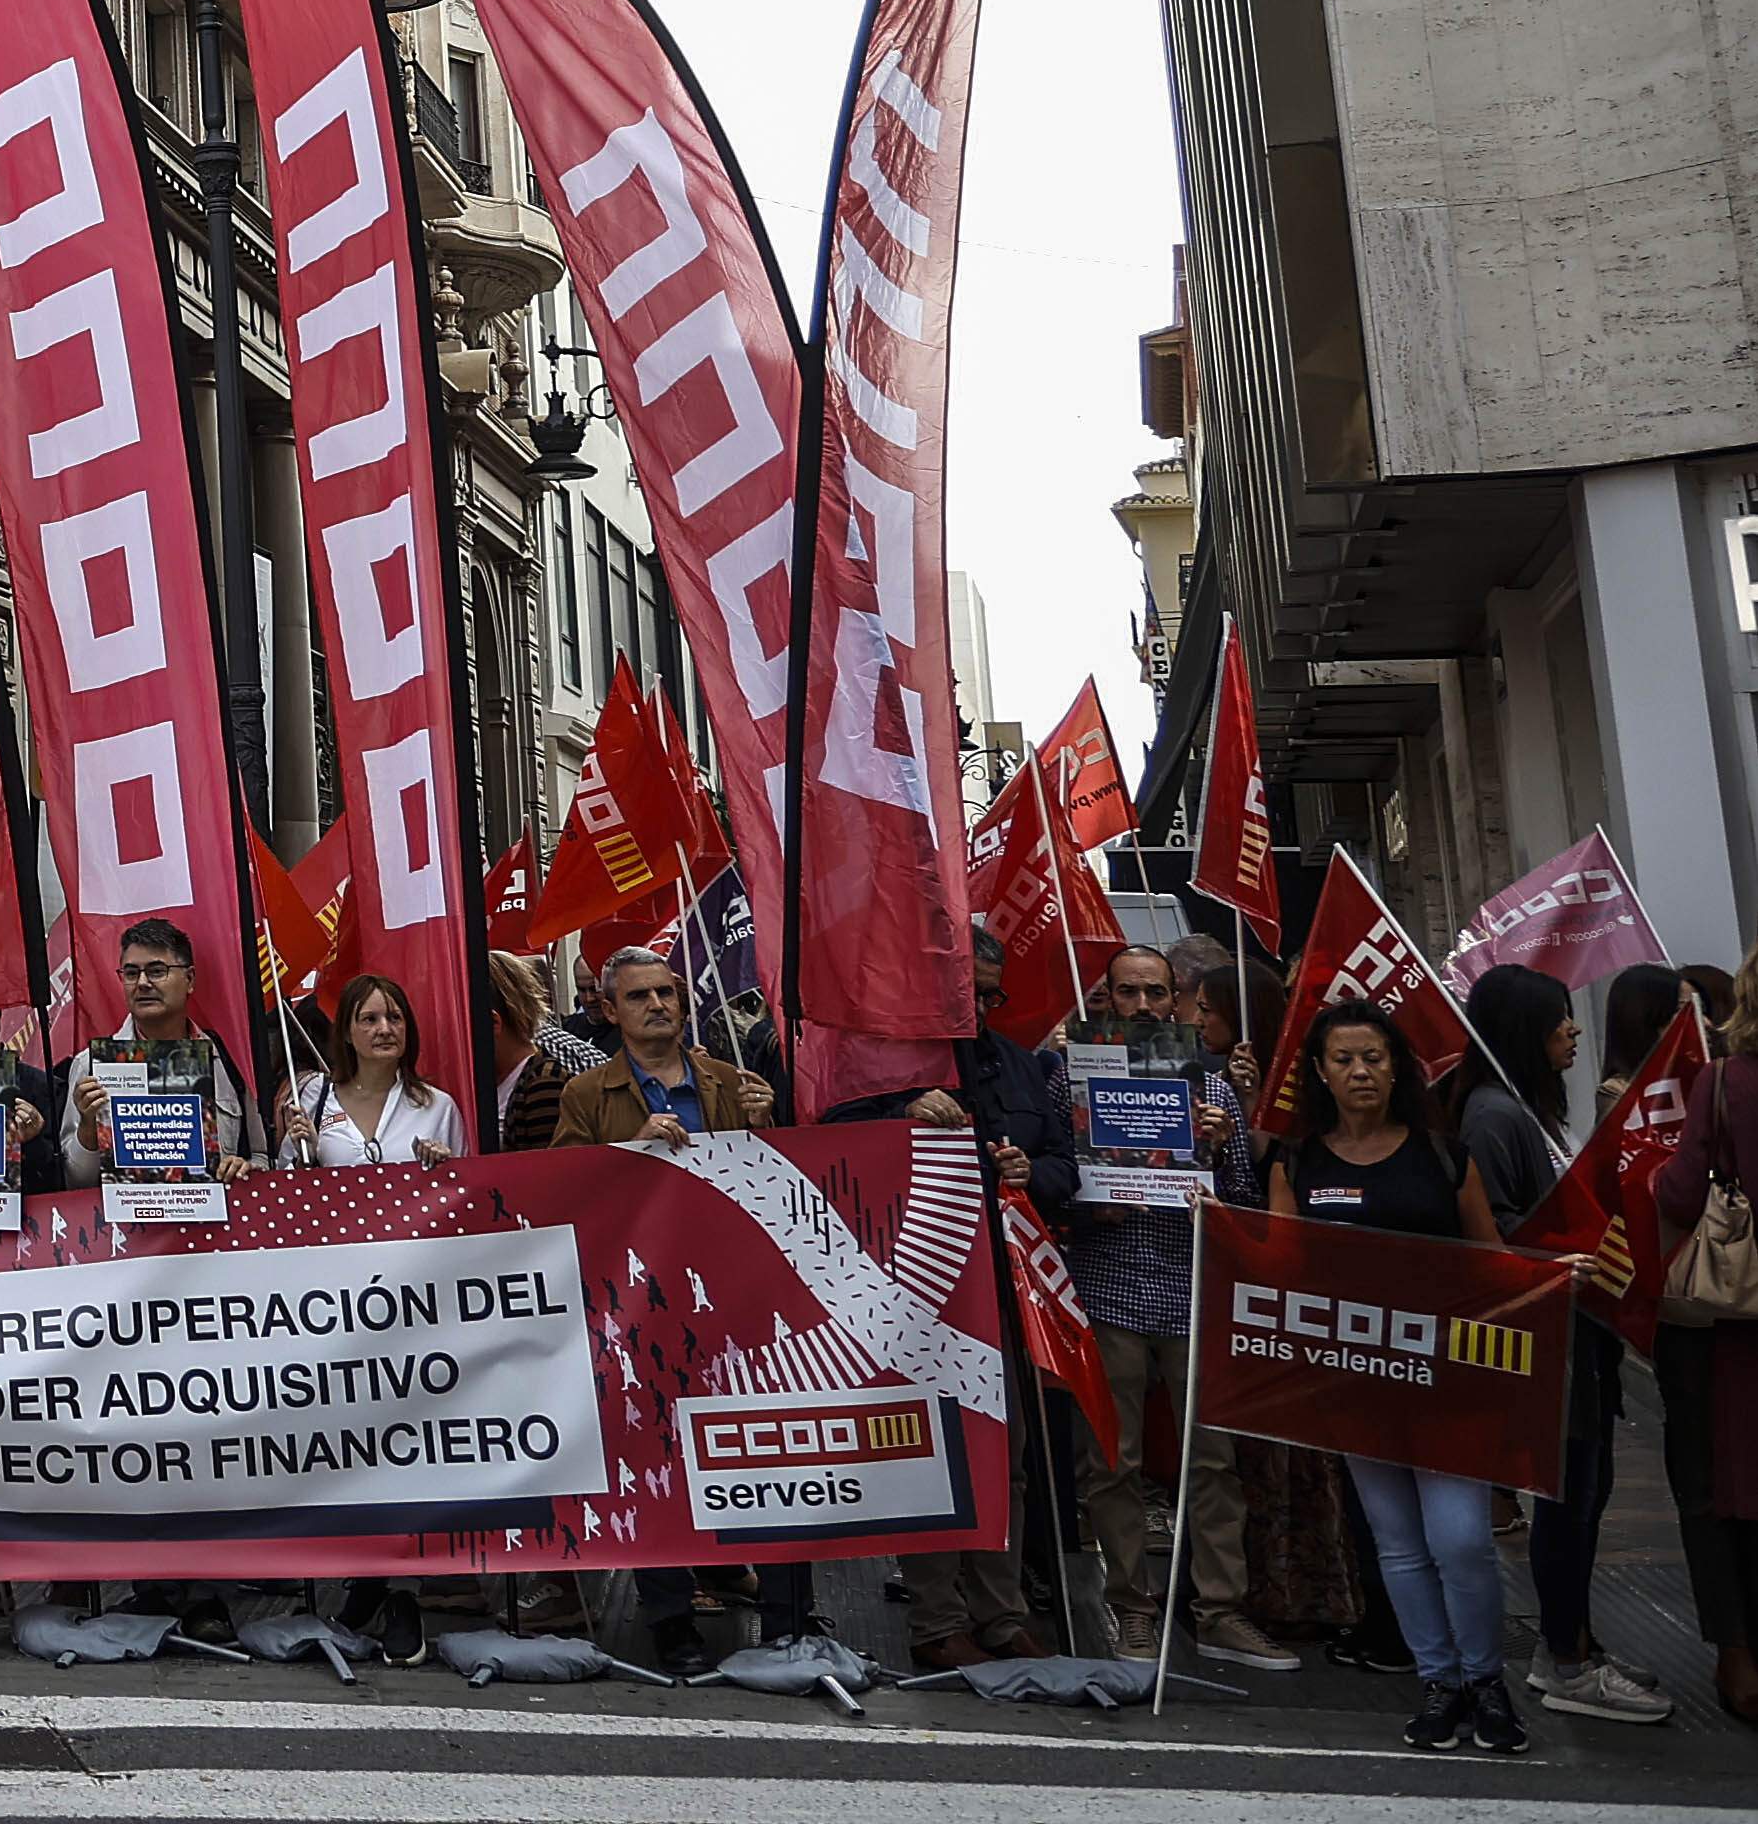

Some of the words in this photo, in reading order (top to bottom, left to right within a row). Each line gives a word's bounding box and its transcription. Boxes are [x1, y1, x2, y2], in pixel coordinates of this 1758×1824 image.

[117, 1103, 194, 1116] EXIGIMOS
[1095, 1091, 1180, 1106] EXIGIMOS
[120, 1122, 151, 1130] pactar
[153, 1120, 193, 1129] medidas
[124, 1132, 146, 1140] para
[147, 1131, 191, 1139] solventar
[126, 1141, 134, 1150] el
[136, 1141, 175, 1152] impacto
[177, 1141, 189, 1149] de
[134, 1152, 142, 1160] la
[144, 1151, 185, 1160] inflación
[458, 1270, 568, 1324] DEL
[1233, 1282, 1437, 1357] CCOO
[1230, 1328, 1296, 1365] país
[1304, 1344, 1434, 1388] valencià
[99, 1352, 460, 1418] ADQUISITIVO
[212, 1413, 561, 1480] FINANCIERO
[703, 1417, 860, 1460] CCOO
[703, 1471, 862, 1512] serveis
